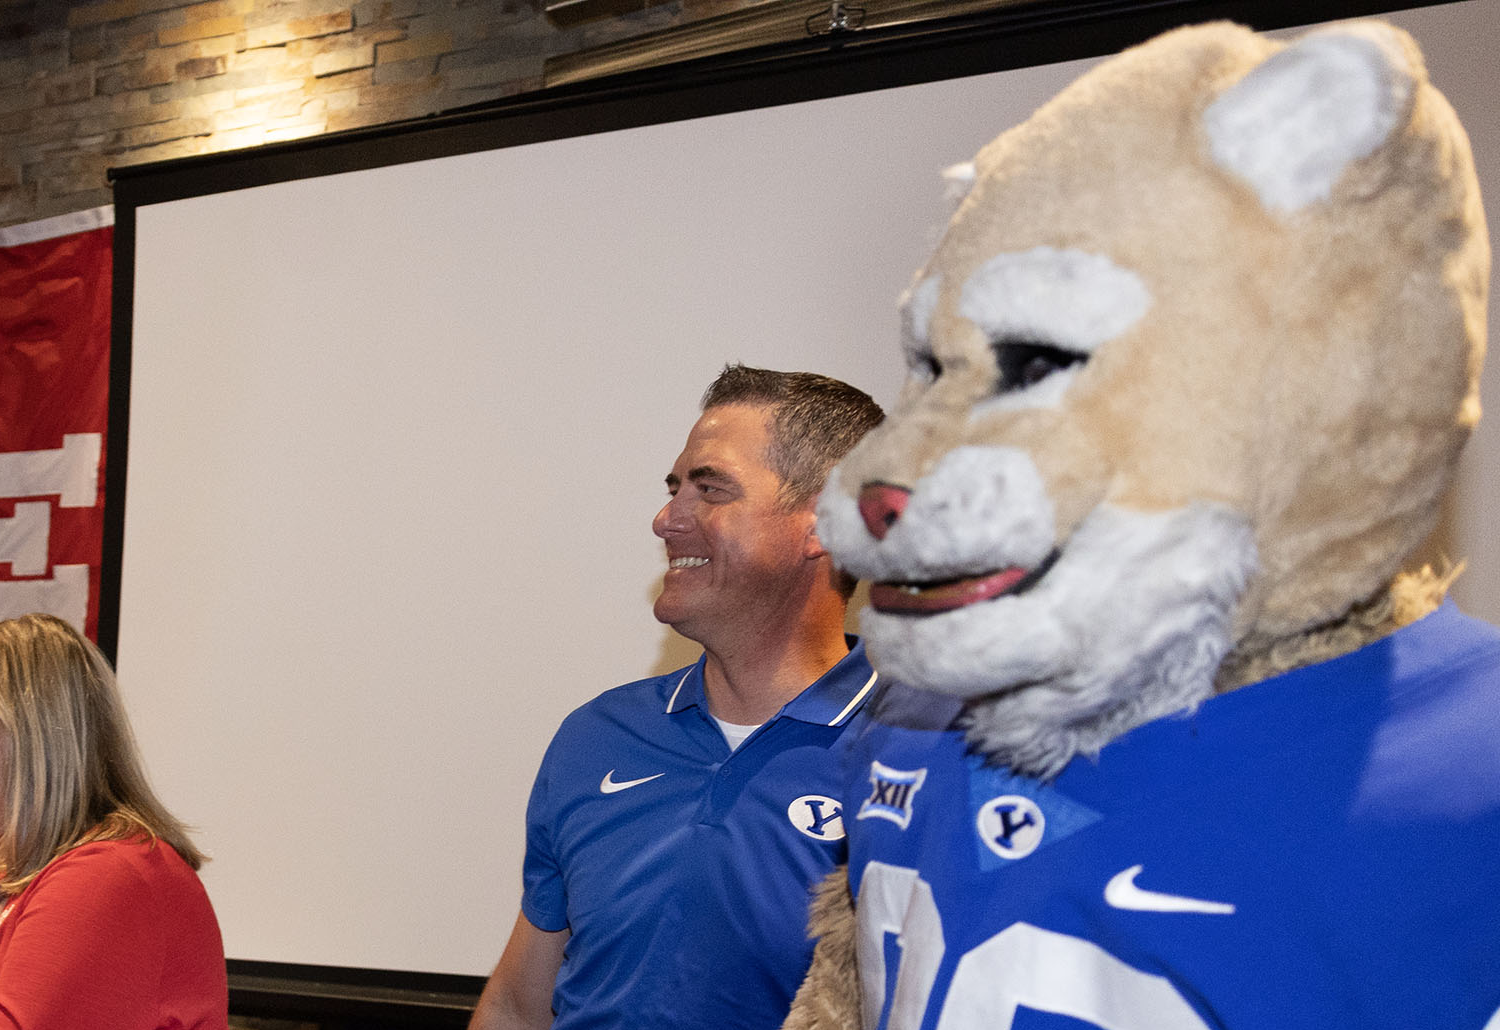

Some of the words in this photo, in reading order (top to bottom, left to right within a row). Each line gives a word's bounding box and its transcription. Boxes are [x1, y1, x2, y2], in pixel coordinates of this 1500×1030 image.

[870, 779, 913, 809] XII
[804, 799, 843, 836] Y
[994, 803, 1036, 850] Y
